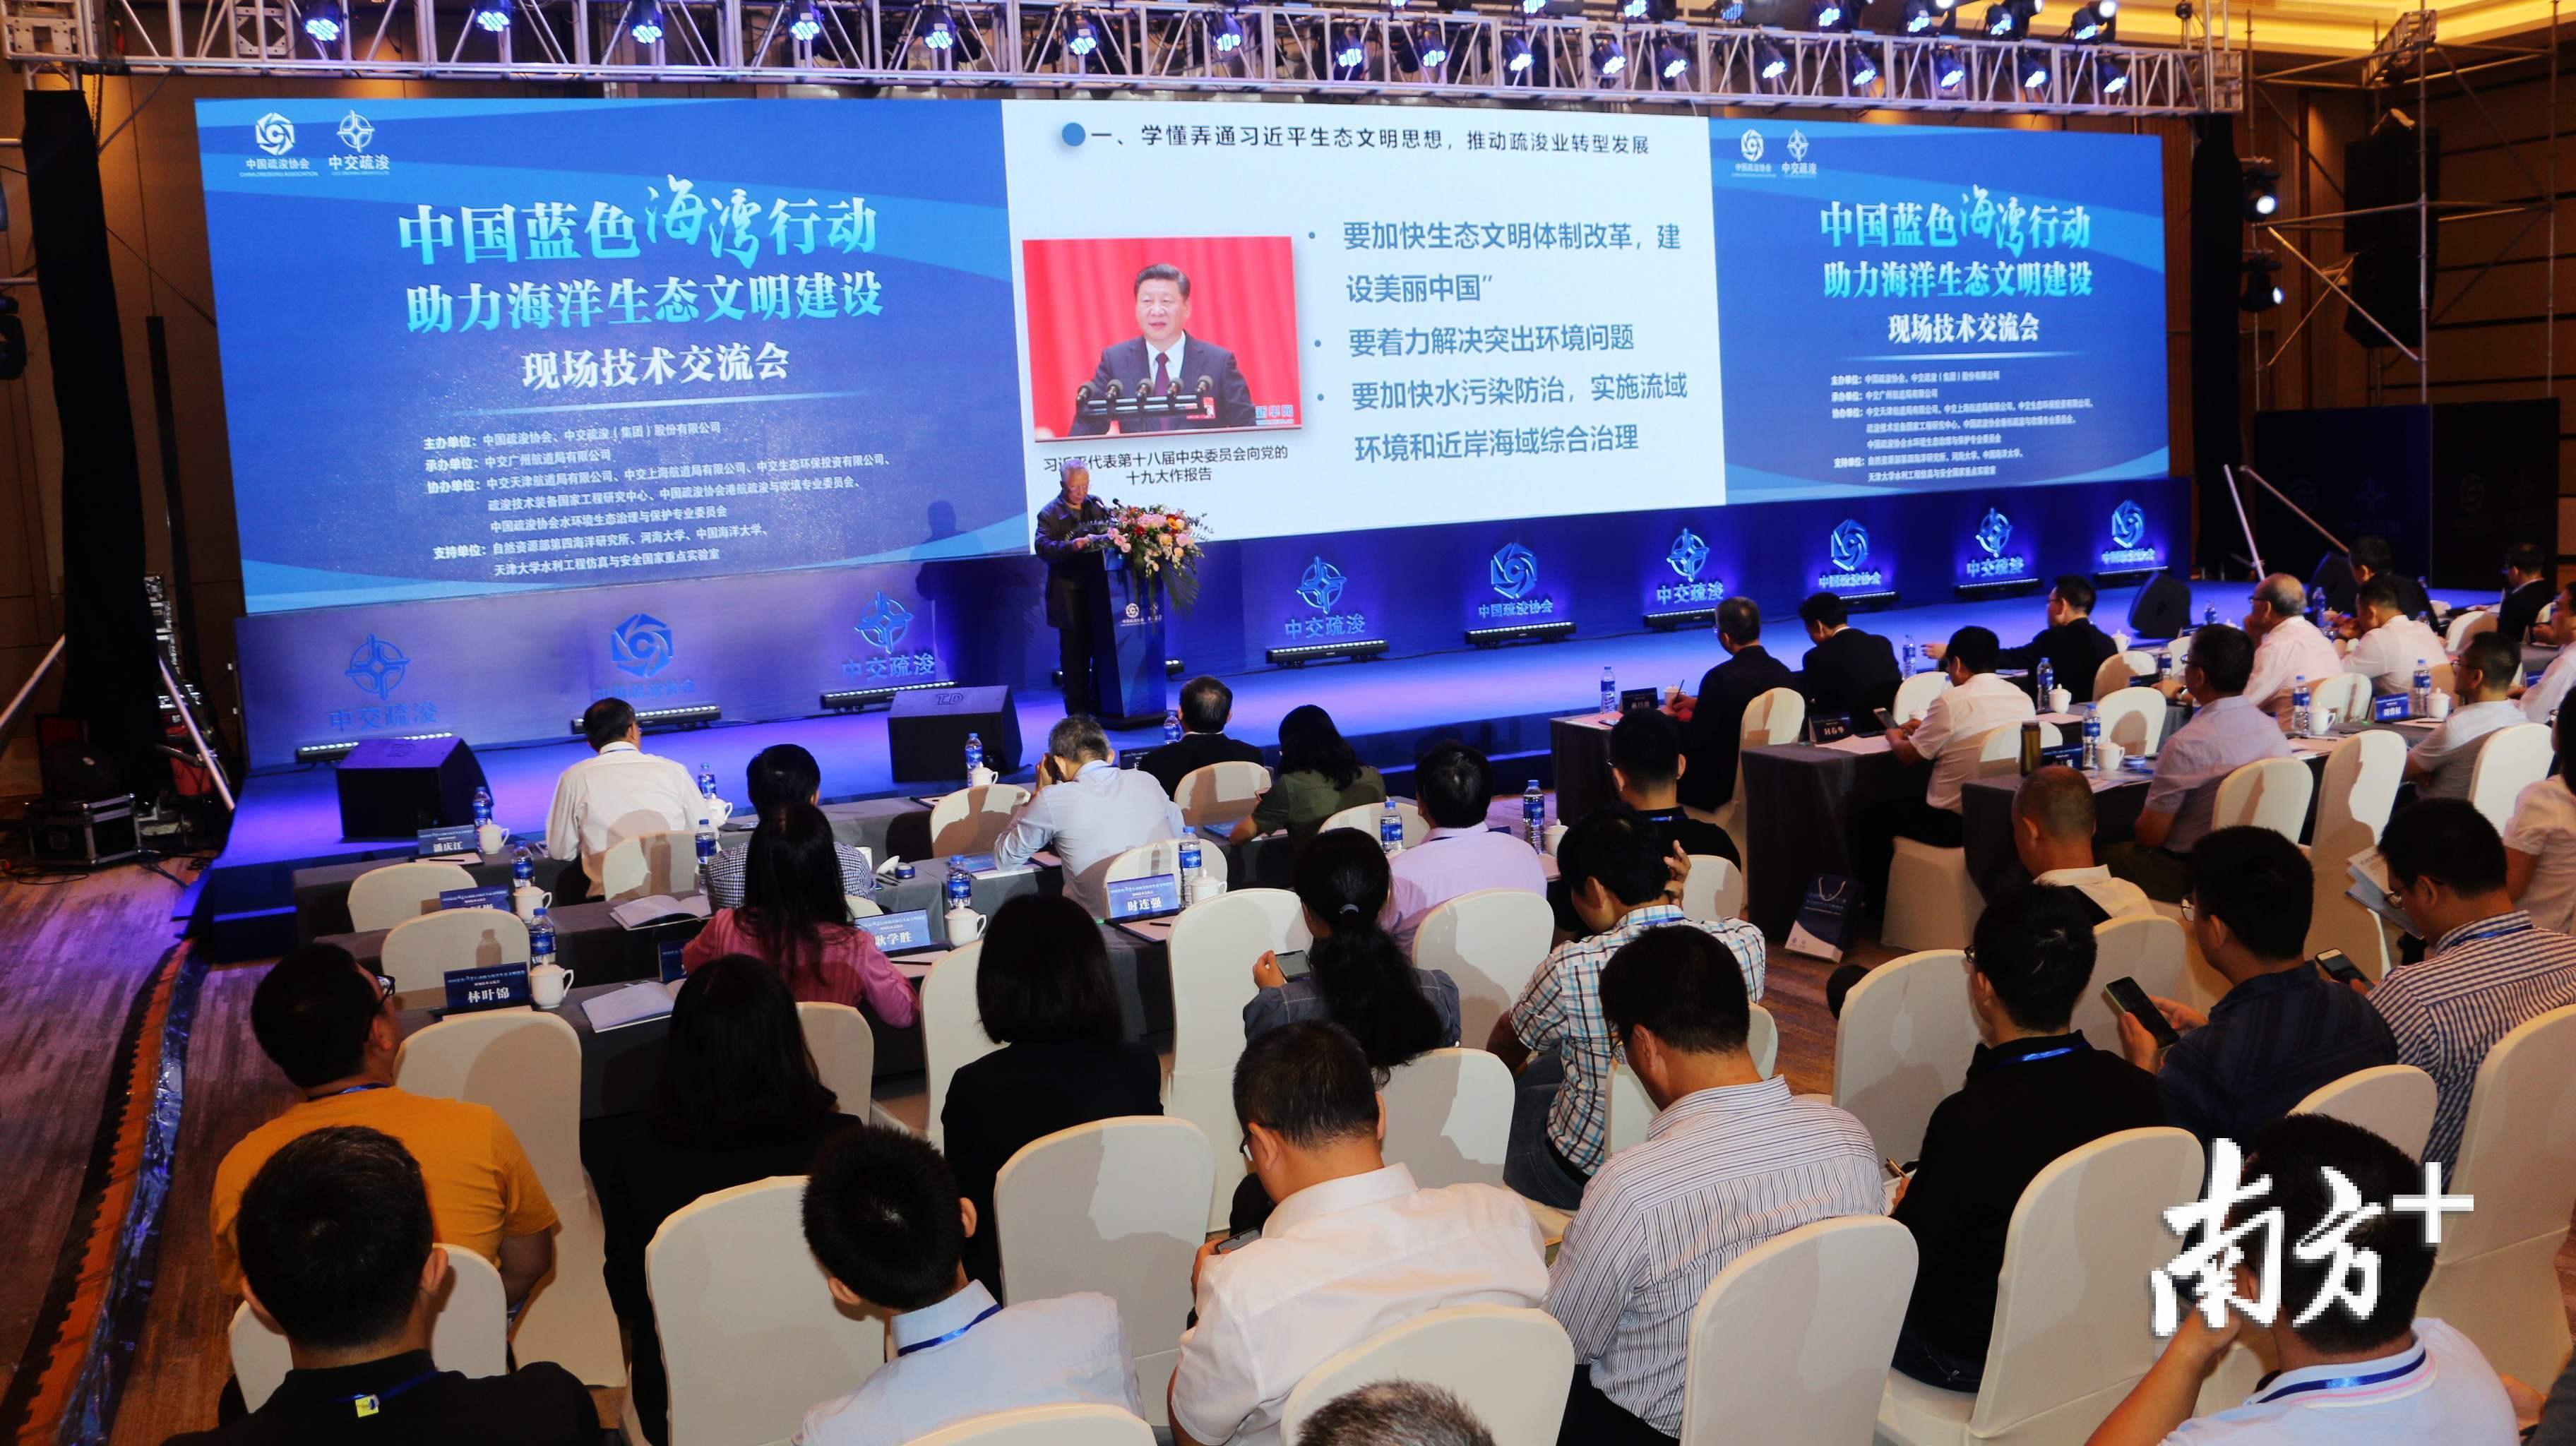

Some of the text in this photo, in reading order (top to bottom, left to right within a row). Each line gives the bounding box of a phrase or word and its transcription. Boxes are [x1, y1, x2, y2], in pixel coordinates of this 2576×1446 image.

[1091, 124, 1650, 155] 一、学懂弄通习近平生态文明思想，推动疏浚业转型发展
[246, 157, 311, 170] 中国疏浚协会
[328, 153, 390, 171] 中交疏浚
[399, 174, 877, 270] 中国蓝色海湾行动
[1820, 184, 2092, 258] 中国蓝色海湾行动
[1343, 221, 1681, 253] 要加快生态文明体制改革，建
[1823, 260, 2093, 298] 助力海洋生态文明建设
[406, 270, 884, 333] 助力海洋生态文明建设
[1888, 311, 2040, 344] 现场技术交流会
[1349, 325, 1635, 358] 要着力解决突出环境问题
[521, 342, 789, 390] 现场技术交流会
[1352, 371, 1688, 412] 要加快水污染防治，实施流域
[1256, 404, 1294, 419] 新华网
[424, 435, 477, 450] 主办单位：
[1354, 424, 1640, 464] 环境和近岸海域综合治理
[425, 448, 612, 472] 承办单位： 中交广州航道局有限公司
[427, 479, 481, 494] 协办单位：
[1126, 468, 1212, 485] 十九大作报告
[433, 544, 487, 560] 支持单位：
[494, 548, 720, 577] 天津大学水利工程仿真与安全国家重点实验室
[1966, 556, 2025, 578] 中交疏浚
[1818, 571, 1882, 589] 中国疏浚协会
[1656, 582, 1724, 604] 中交疏浚
[1478, 599, 1554, 619] 中国疏浚协会
[1284, 614, 1366, 638] 中交疏浚
[842, 652, 935, 681] 中交疏浚
[329, 701, 438, 733] 中交疏浚
[1127, 897, 1162, 912] 时连强
[467, 987, 510, 1003] 林叶锦
